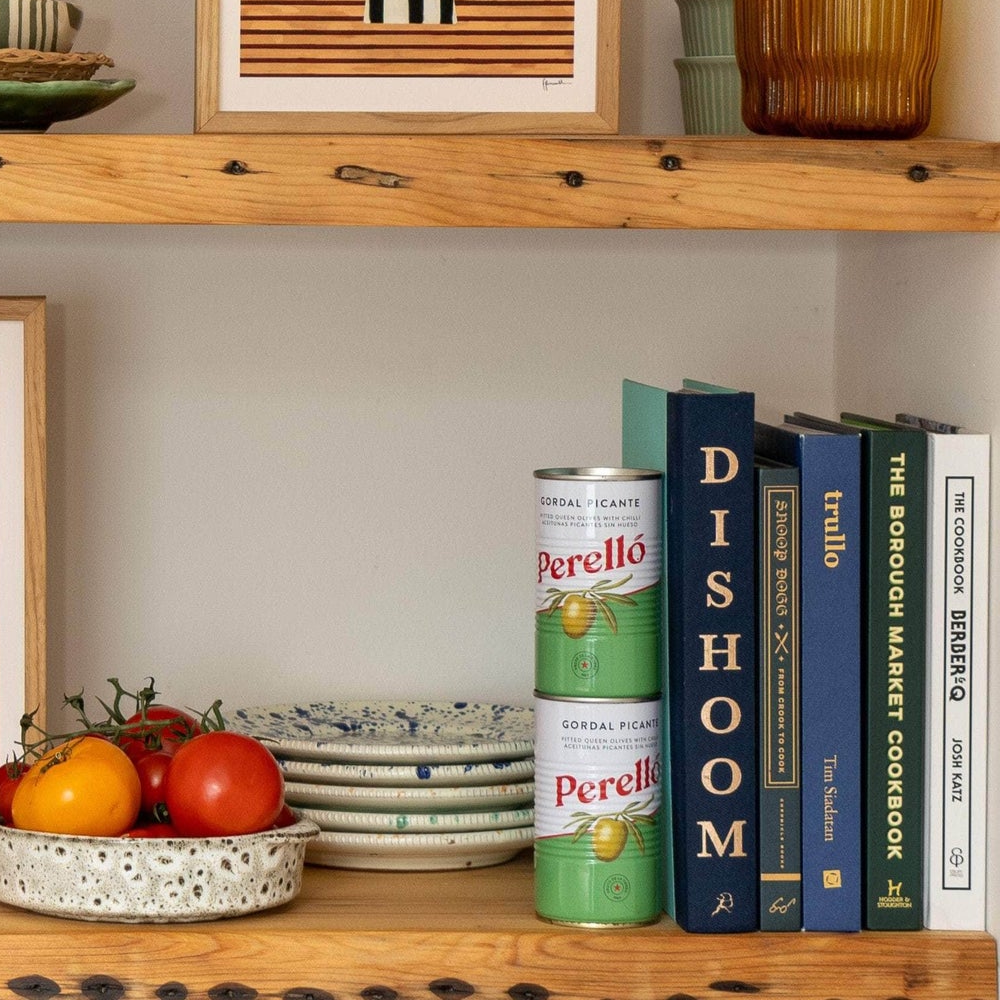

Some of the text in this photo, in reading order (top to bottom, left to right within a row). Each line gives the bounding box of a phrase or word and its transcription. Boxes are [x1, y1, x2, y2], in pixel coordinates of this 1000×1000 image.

[540, 497, 641, 508] GORDAL PICANTE
[954, 491, 965, 513] THE
[824, 489, 846, 569] trullo
[537, 533, 646, 583] Perelló
[953, 517, 965, 594] COOKBOOK
[697, 446, 748, 858] DISHOOM
[887, 452, 906, 860] THE BOROUGH MARKET COOKBOOK
[777, 668, 785, 695] FROM
[562, 718, 659, 731] GORDAL PICANTE
[777, 697, 785, 729] CROOK
[778, 732, 785, 744] TO
[555, 753, 662, 808] Perelló
[951, 738, 963, 803] JOSH KATZ
[823, 755, 839, 842] Tim Siadatan
